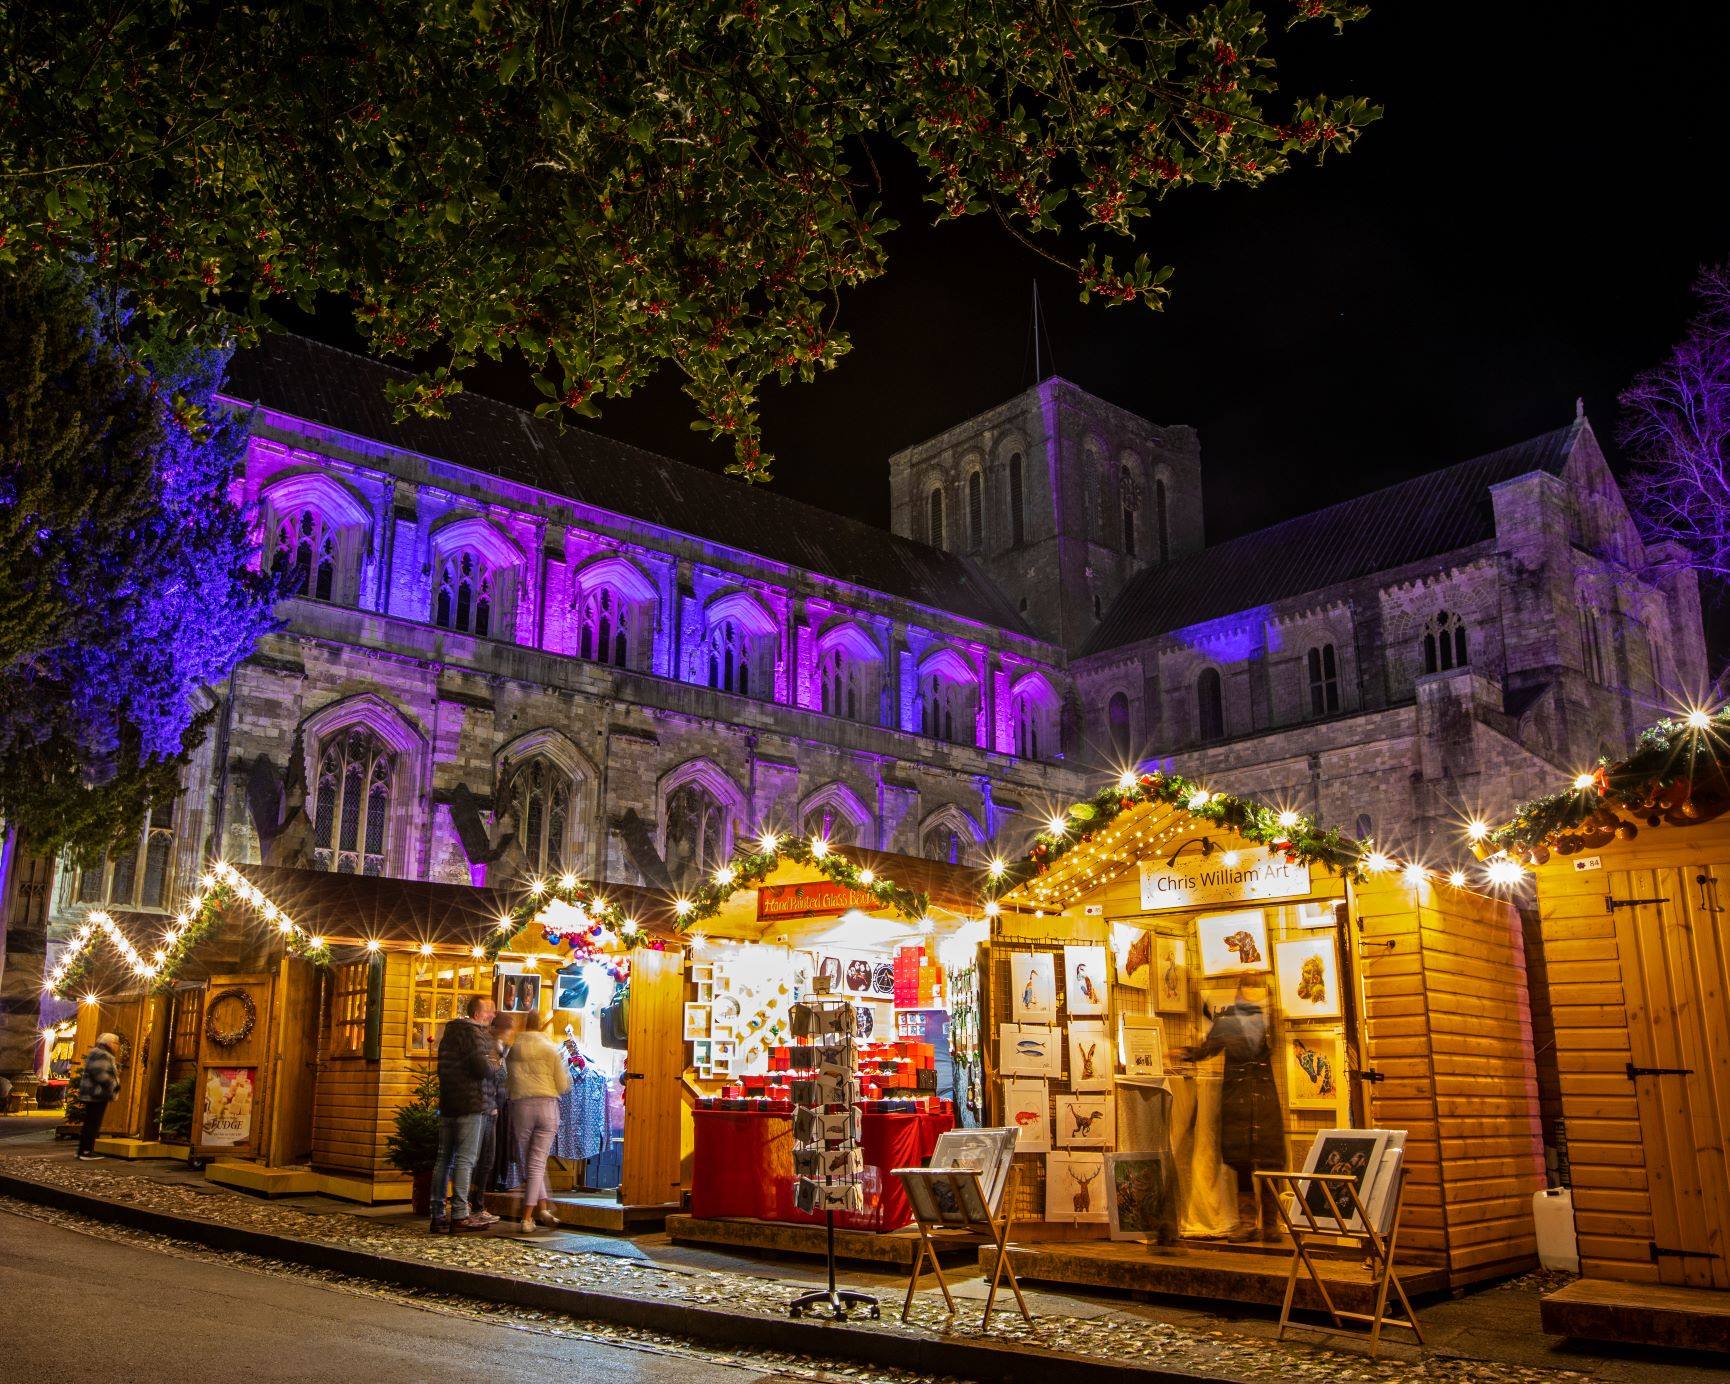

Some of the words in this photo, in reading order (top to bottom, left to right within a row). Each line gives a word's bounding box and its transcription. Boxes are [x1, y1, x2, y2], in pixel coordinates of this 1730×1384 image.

[1589, 859, 1600, 867] 84
[1157, 874, 1196, 892] Chris
[1200, 868, 1259, 887] William
[1264, 864, 1289, 880] Art
[764, 896, 789, 912] Hand
[789, 893, 821, 910] Painted
[822, 892, 848, 908] Glass
[211, 1119, 244, 1130] FUDGE
